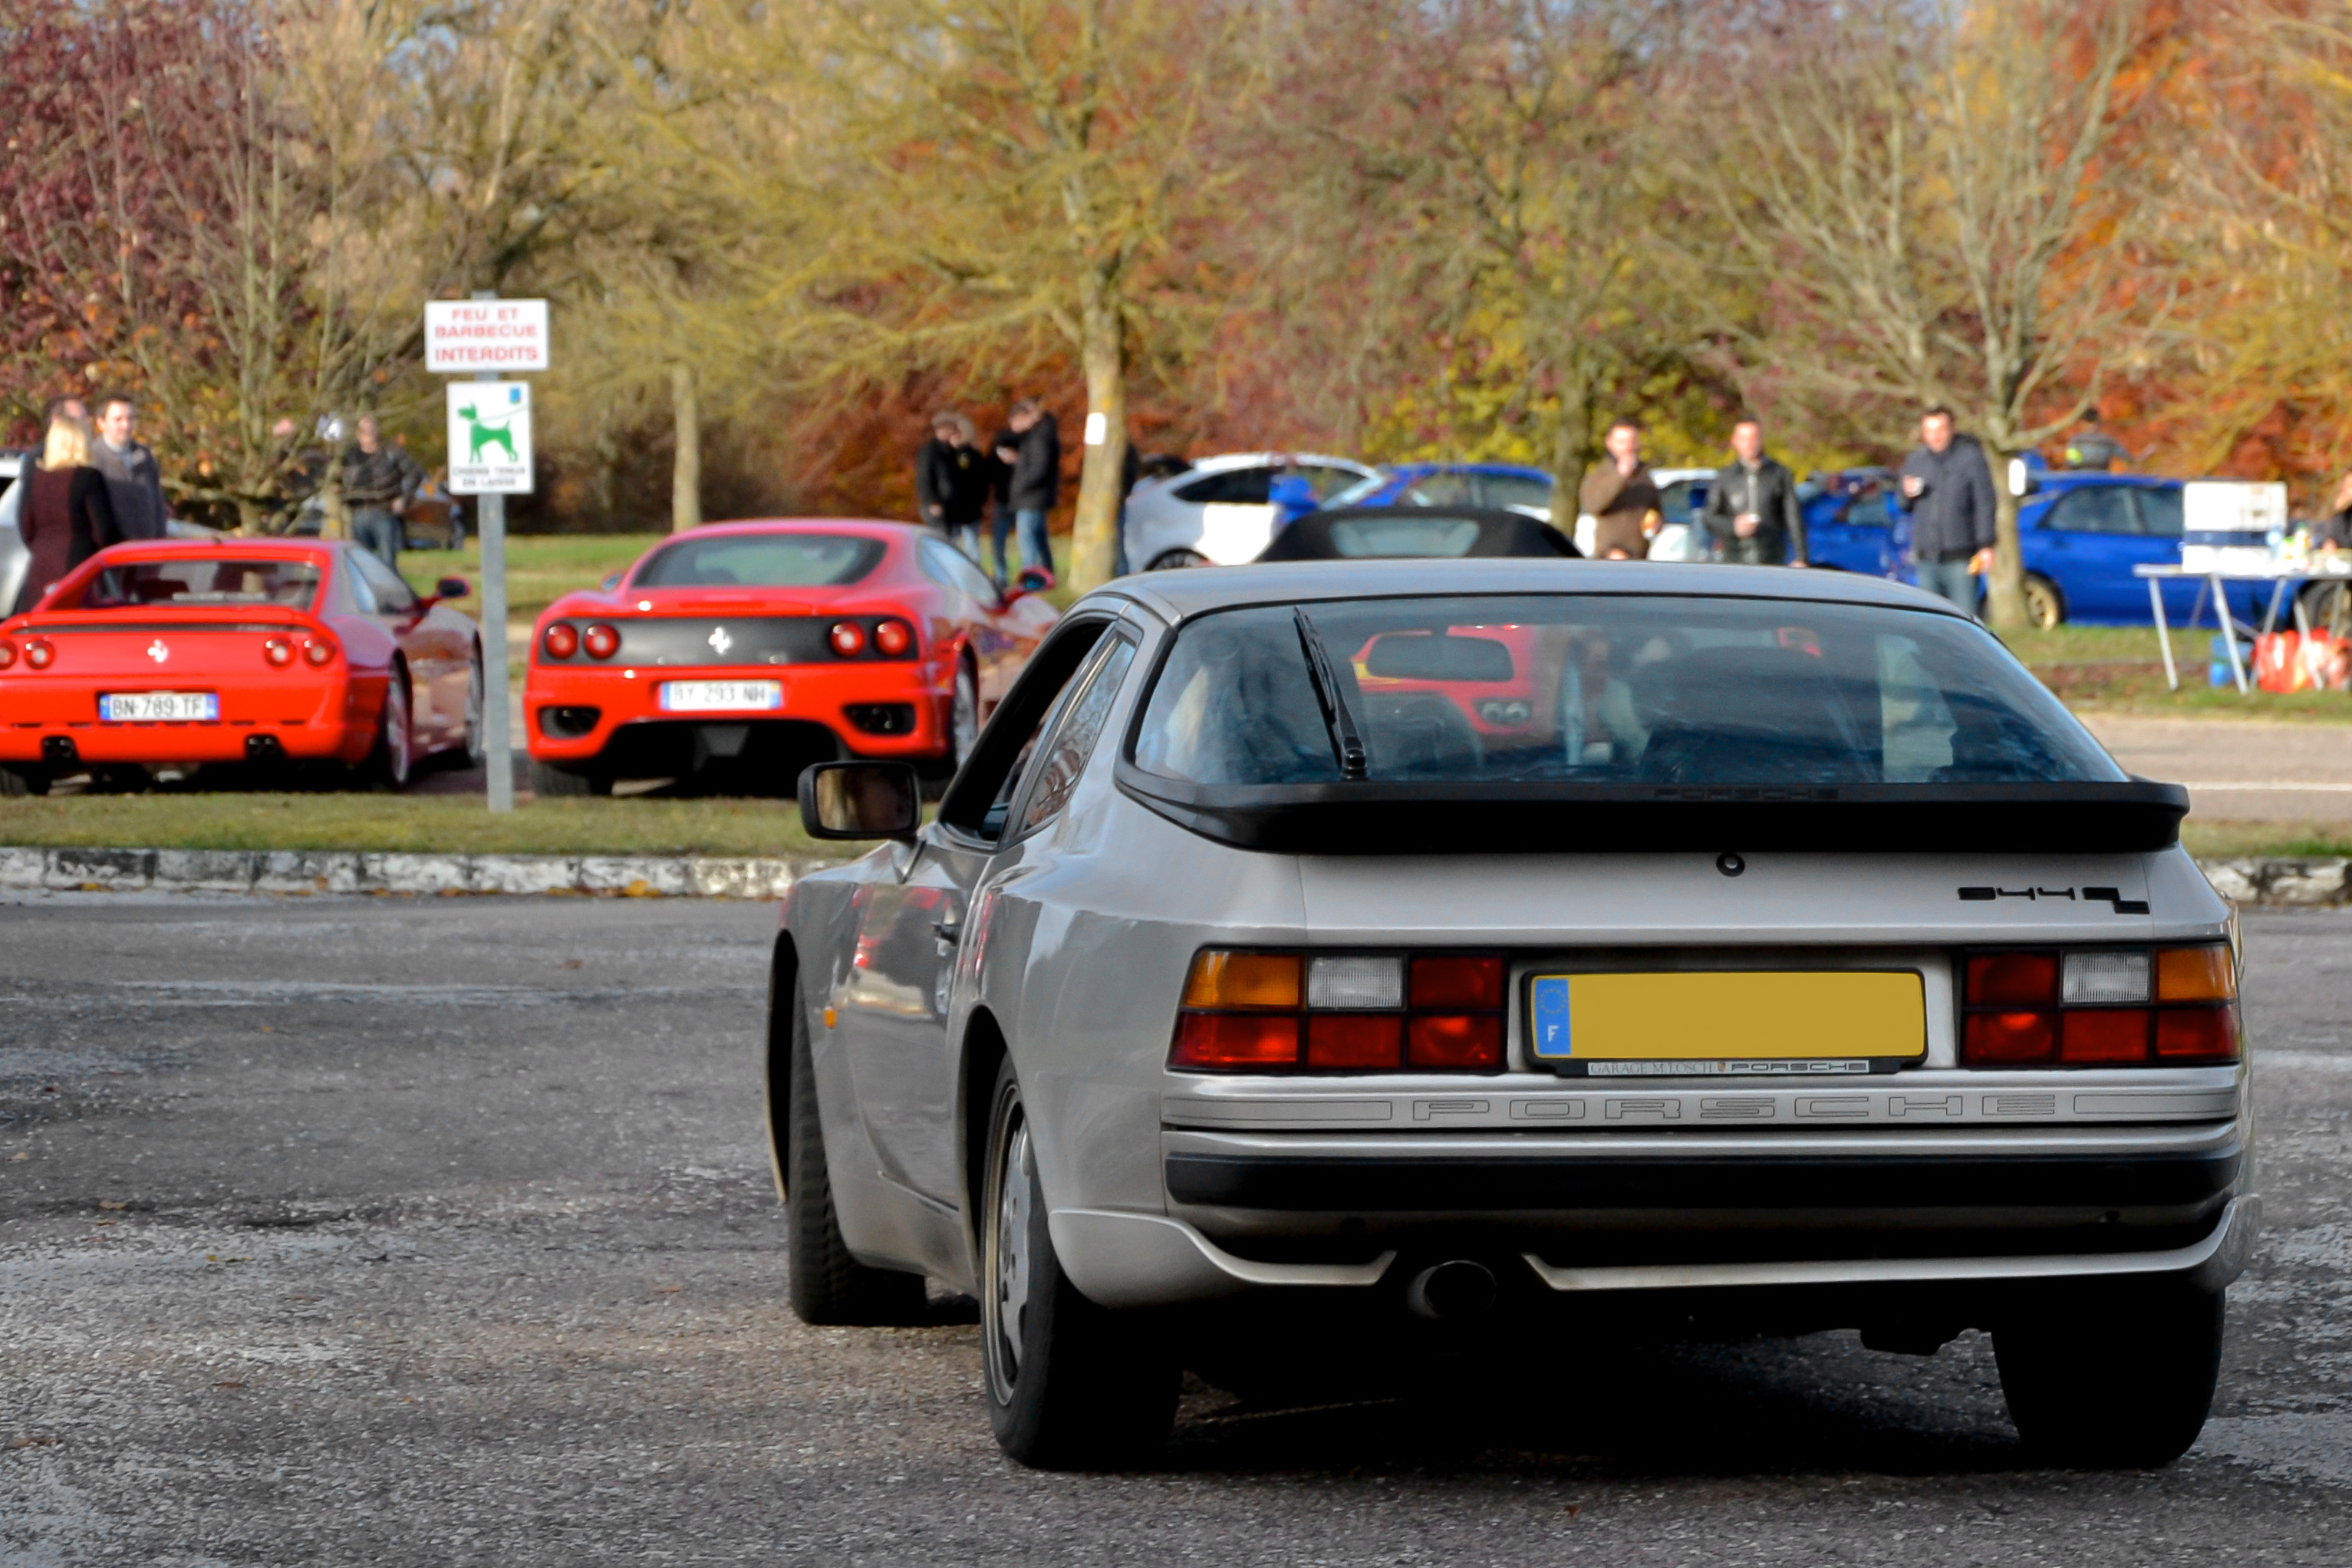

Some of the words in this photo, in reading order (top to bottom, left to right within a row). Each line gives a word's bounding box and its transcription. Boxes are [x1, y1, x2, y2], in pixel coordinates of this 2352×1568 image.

[452, 308, 488, 321] FEU
[498, 308, 519, 321] ET
[434, 324, 538, 338] BARBECUE
[435, 346, 539, 362] INTERDITS
[1653, 788, 1840, 800] PORSCHE
[1547, 1024, 1560, 1043] F
[1589, 1062, 1645, 1074] GARAGE
[1731, 1062, 1867, 1072] PORSCHE
[1412, 1095, 2055, 1121] PORSCHE
